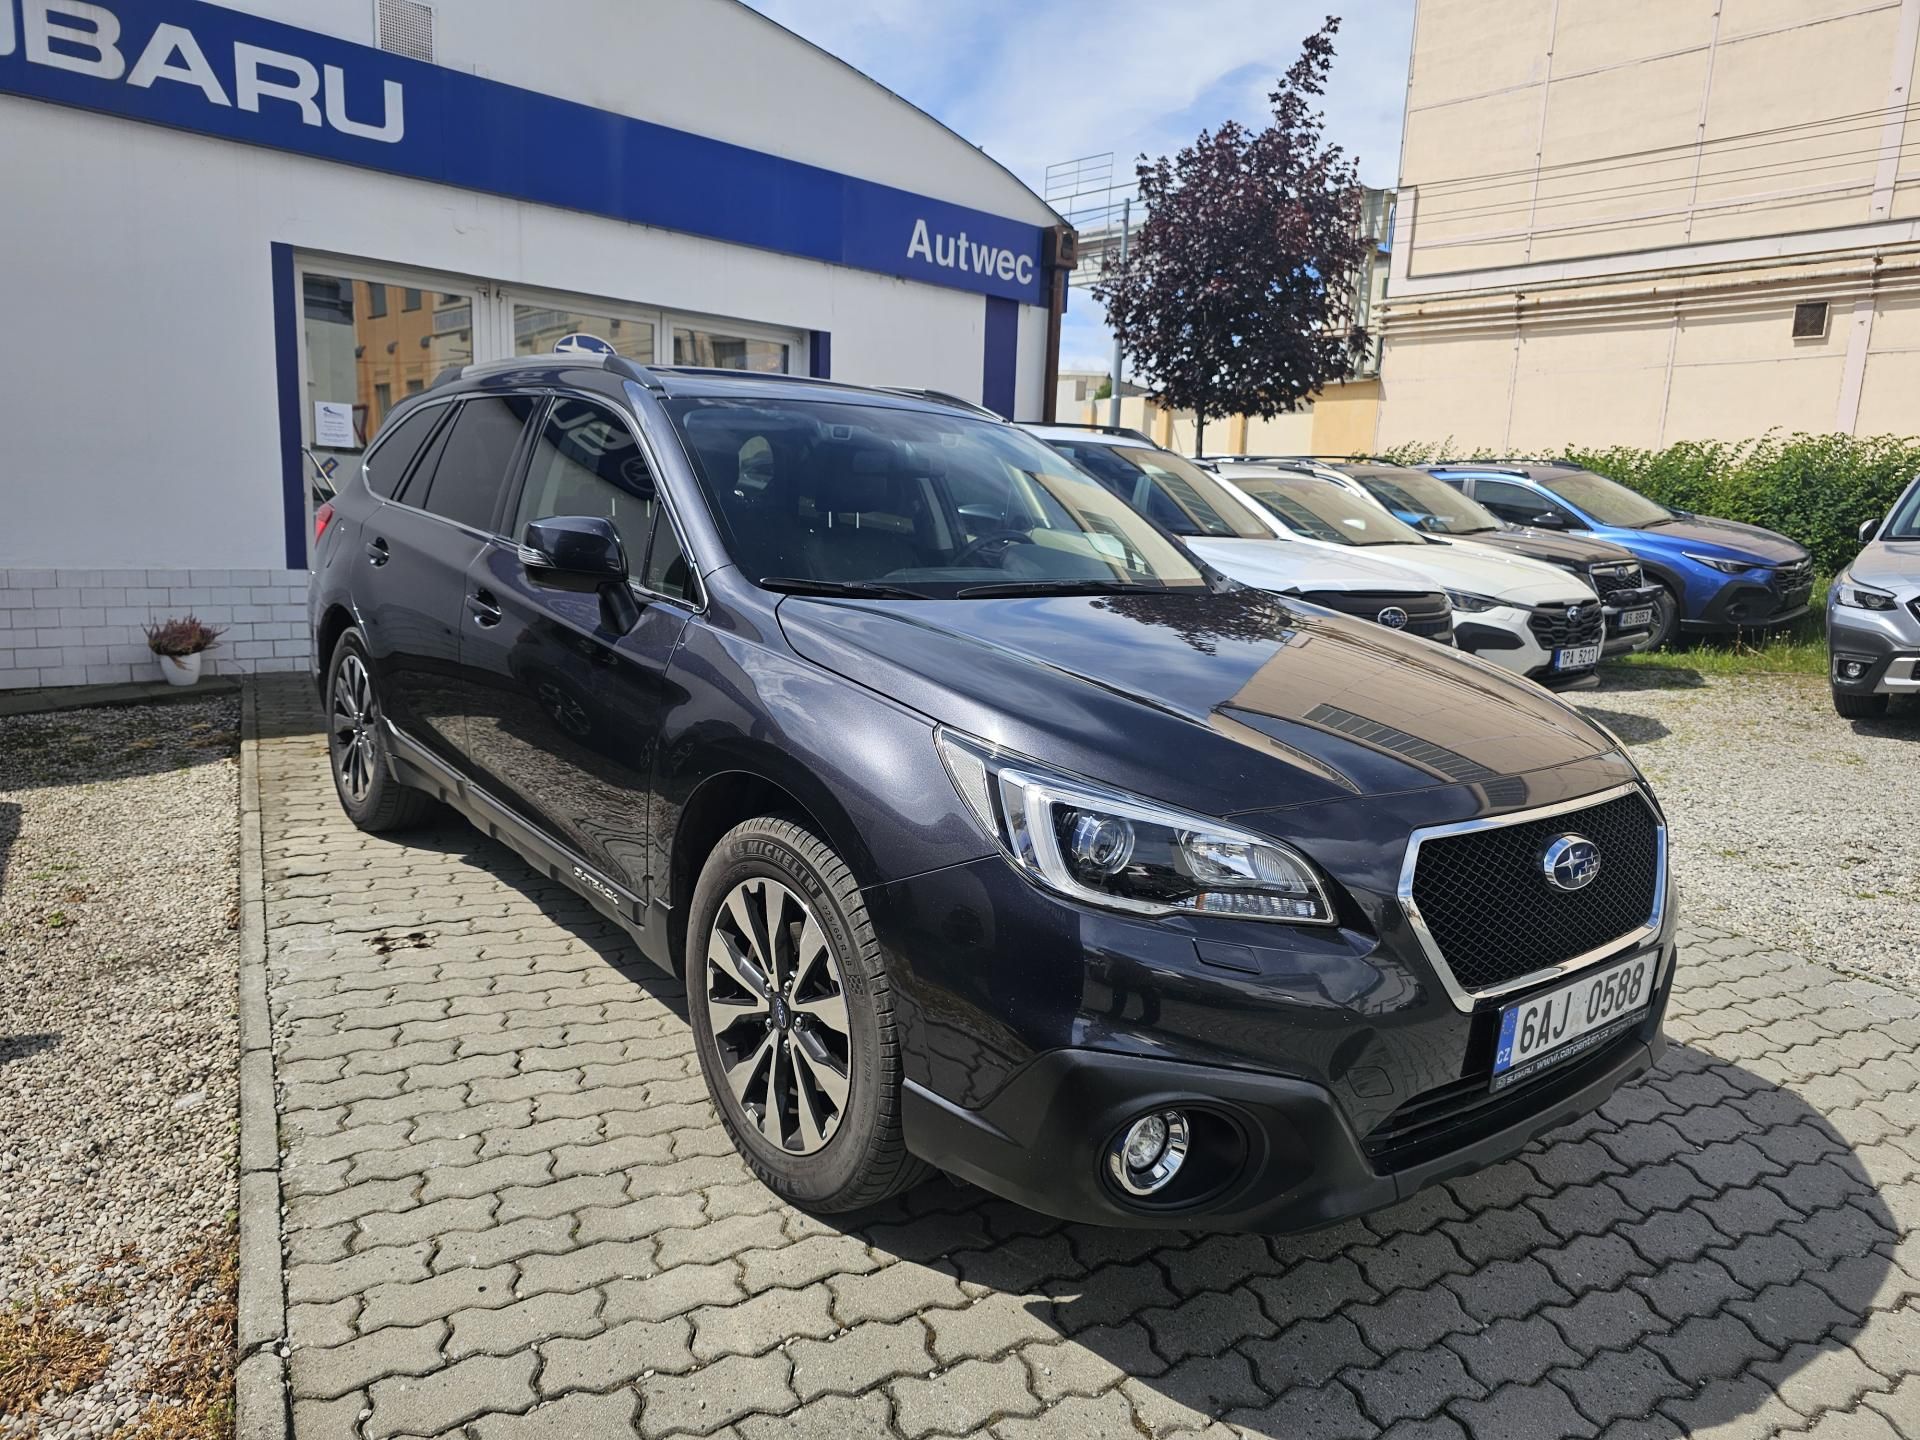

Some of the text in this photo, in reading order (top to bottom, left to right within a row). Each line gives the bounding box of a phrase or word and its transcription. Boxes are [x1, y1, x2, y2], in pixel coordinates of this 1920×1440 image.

[0, 0, 404, 143] BARU
[906, 218, 1033, 285] Autwec
[1562, 650, 1574, 665] 1PA
[1578, 648, 1595, 663] 5213
[573, 866, 619, 905] OUTBACK
[746, 840, 818, 894] MICHELIN
[822, 904, 843, 941] 225/60
[1519, 962, 1646, 1054] 6AJ 0588
[1496, 1046, 1511, 1065] CZ
[1506, 1065, 1535, 1083] SUBARU
